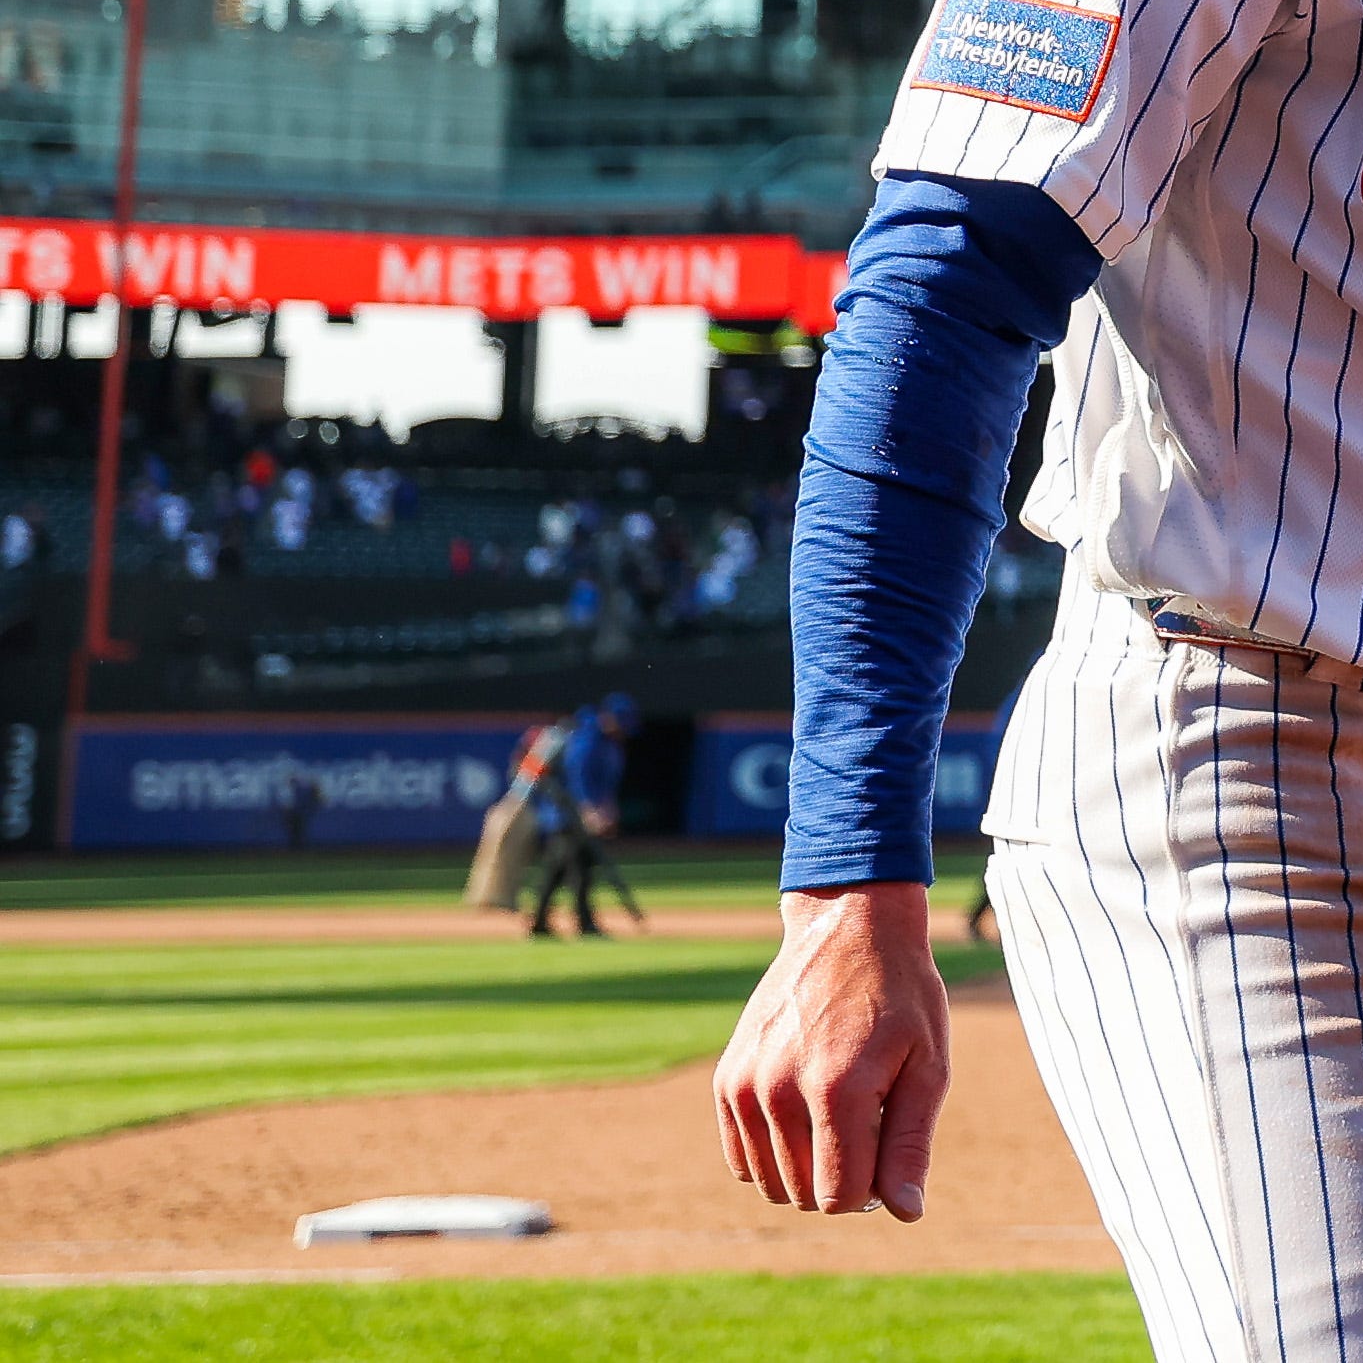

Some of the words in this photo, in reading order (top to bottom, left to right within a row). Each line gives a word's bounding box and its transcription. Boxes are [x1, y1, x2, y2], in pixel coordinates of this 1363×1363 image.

[952, 37, 1084, 86] Presbyterian
[97, 231, 257, 301] WIN
[378, 244, 575, 306] METS
[593, 245, 741, 308] WIN
